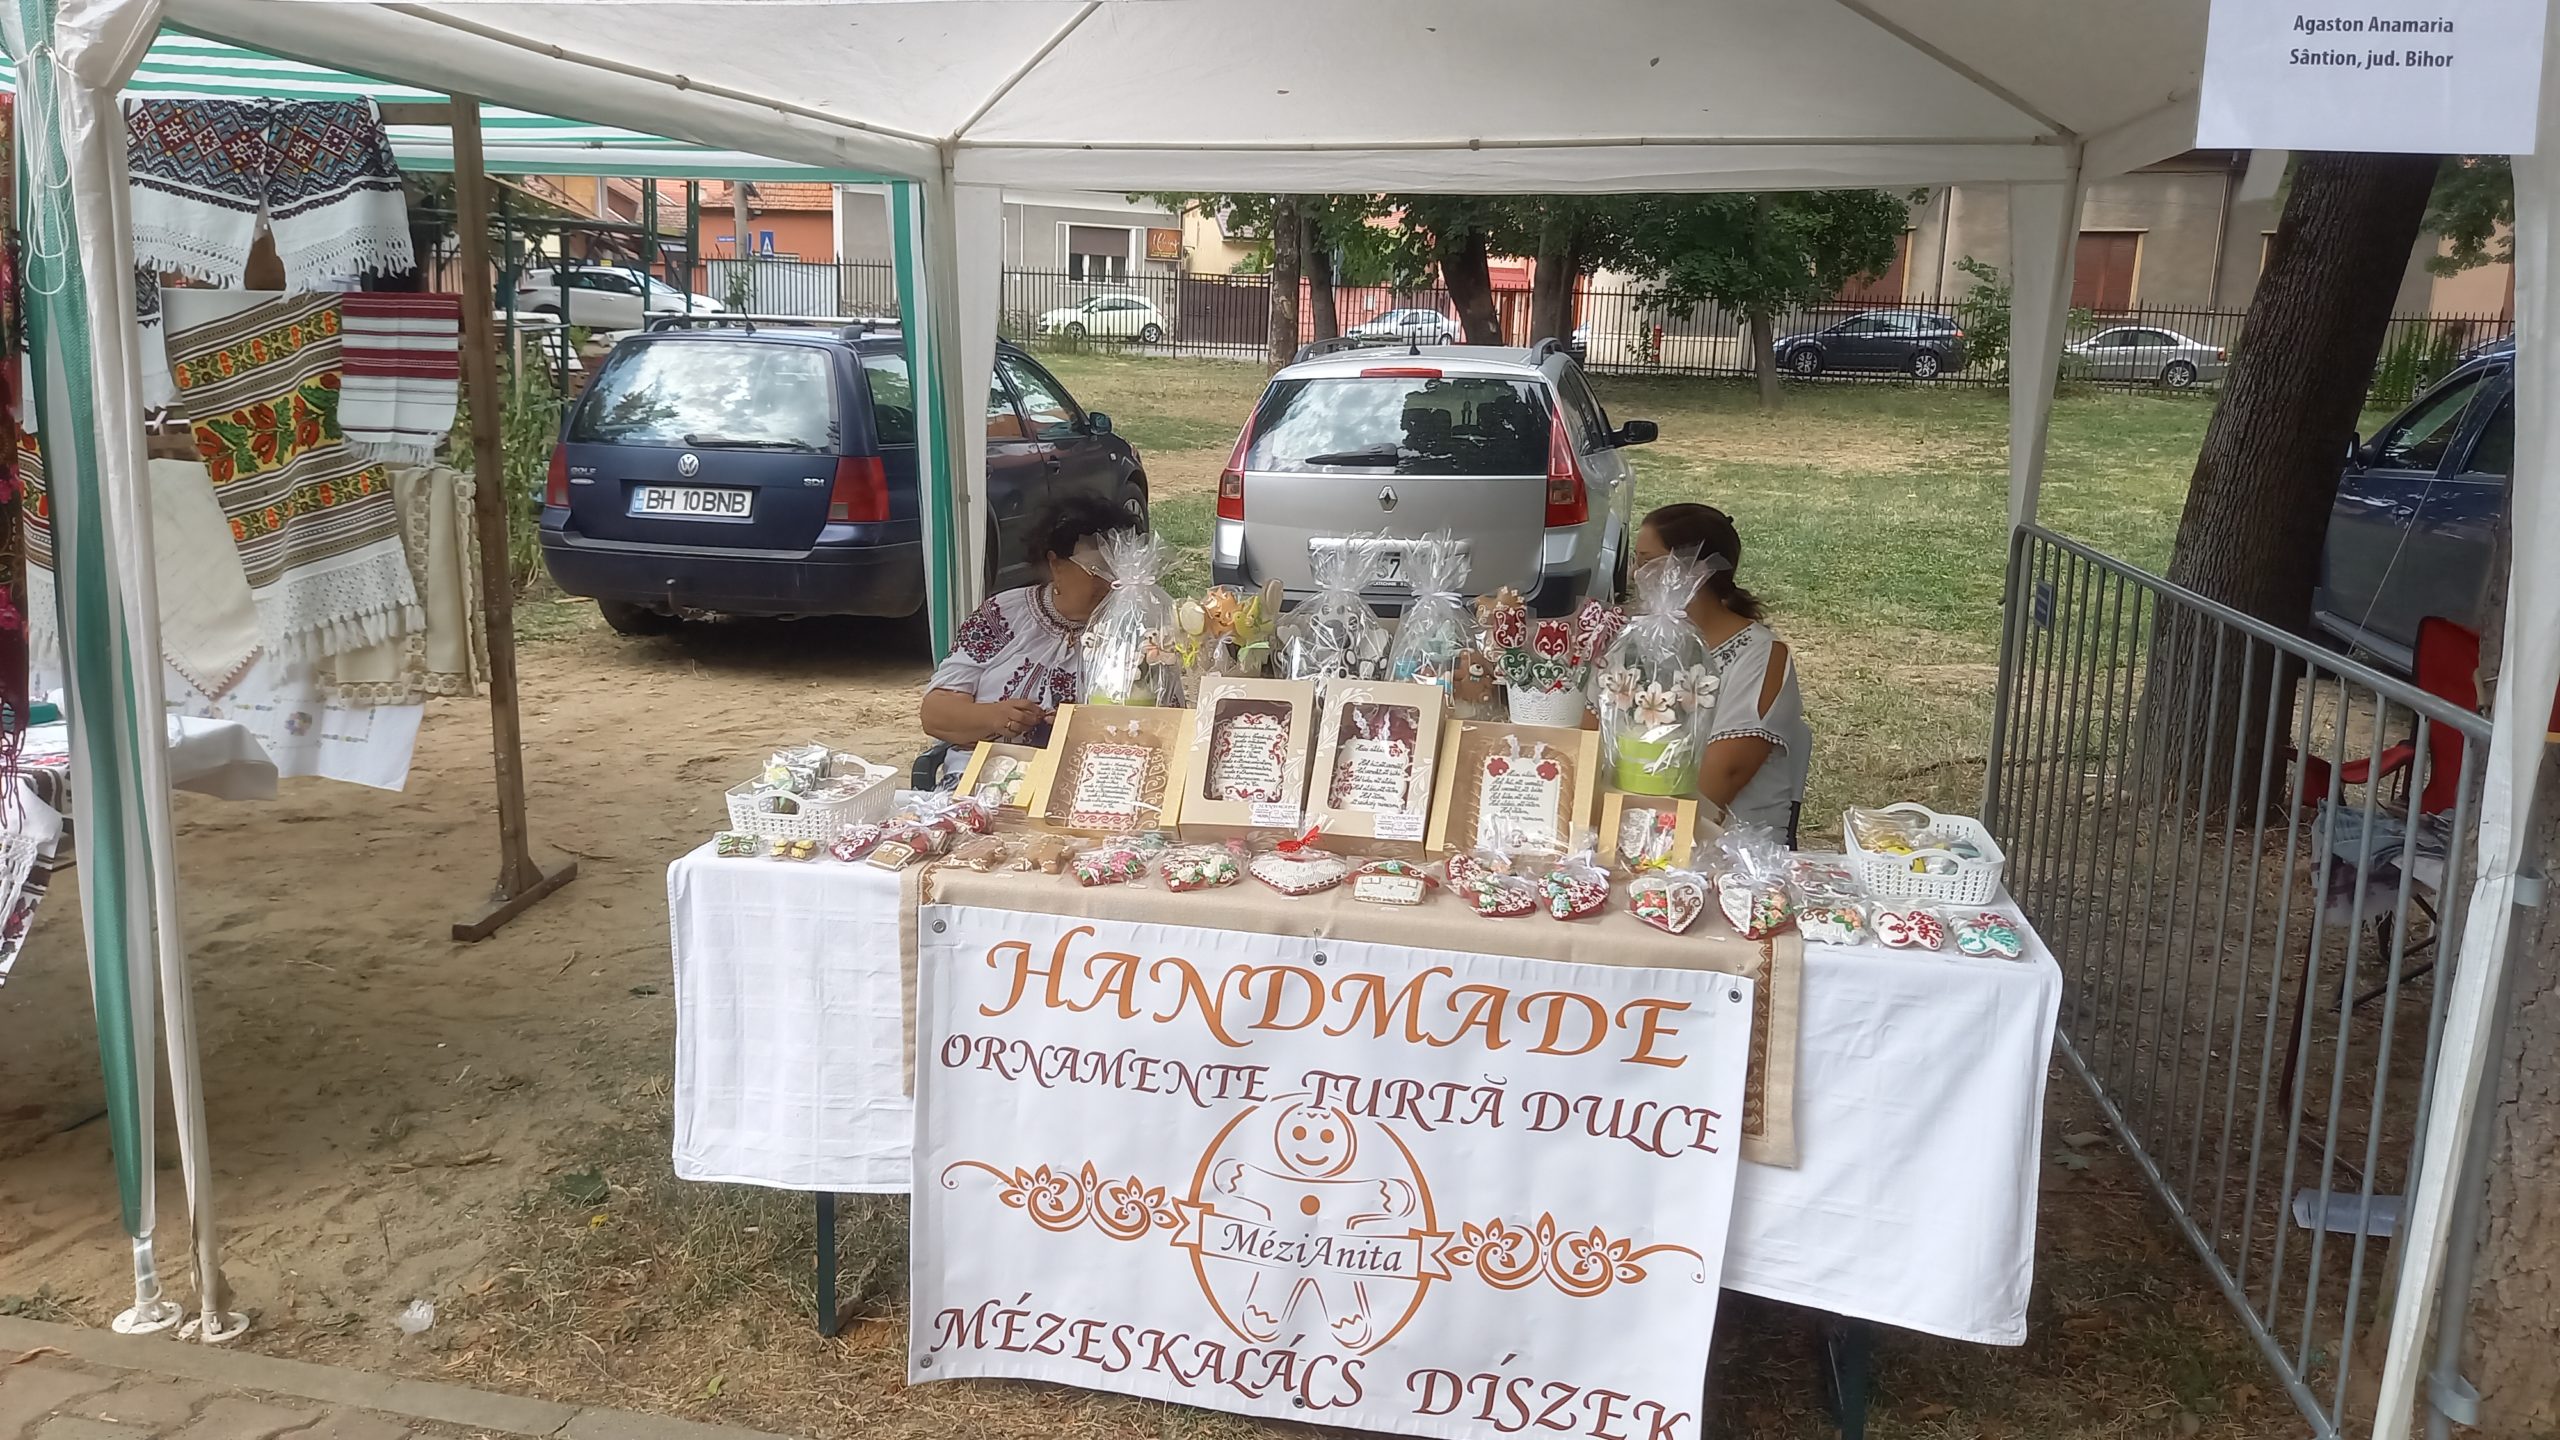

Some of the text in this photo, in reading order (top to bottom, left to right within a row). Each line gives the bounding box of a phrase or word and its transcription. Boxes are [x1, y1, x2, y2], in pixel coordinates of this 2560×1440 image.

[2293, 15, 2455, 36] Agaston Anamaria
[2289, 48, 2455, 70] Sântion, jud. Bihor
[645, 489, 676, 511] BH
[979, 925, 1692, 1069] HANDMADE
[940, 1032, 1723, 1159] ORNAMENTE TURTĂ DULCE
[1220, 1222, 1403, 1273] MéziAnita
[929, 1291, 1692, 1440] MÉZESKALÁCS DÍSZEK
